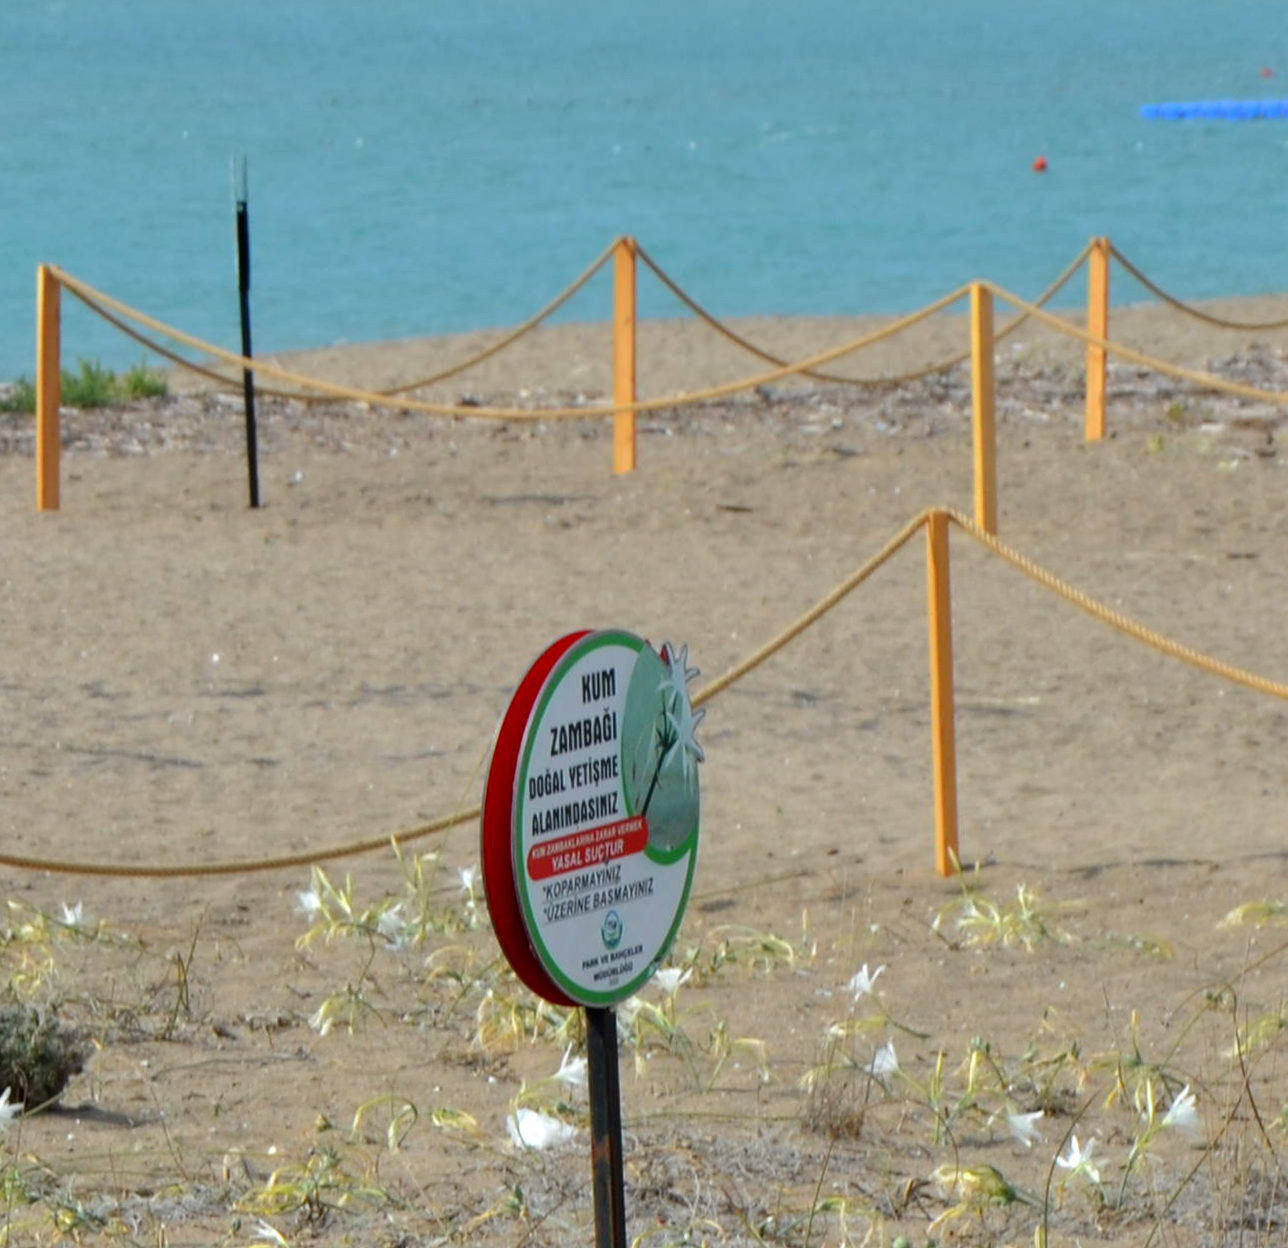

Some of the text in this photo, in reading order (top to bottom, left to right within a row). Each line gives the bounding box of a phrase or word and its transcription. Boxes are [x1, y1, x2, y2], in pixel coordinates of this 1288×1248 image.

[581, 667, 616, 704] KUM
[550, 708, 617, 757] ZAMBAĞI
[529, 755, 619, 799] DOĞAL YETİŞME
[532, 792, 618, 837] ALANINDASINIZ
[552, 839, 624, 872] YASAL SUÇTUR
[593, 877, 654, 909] BASMAYINIZ
